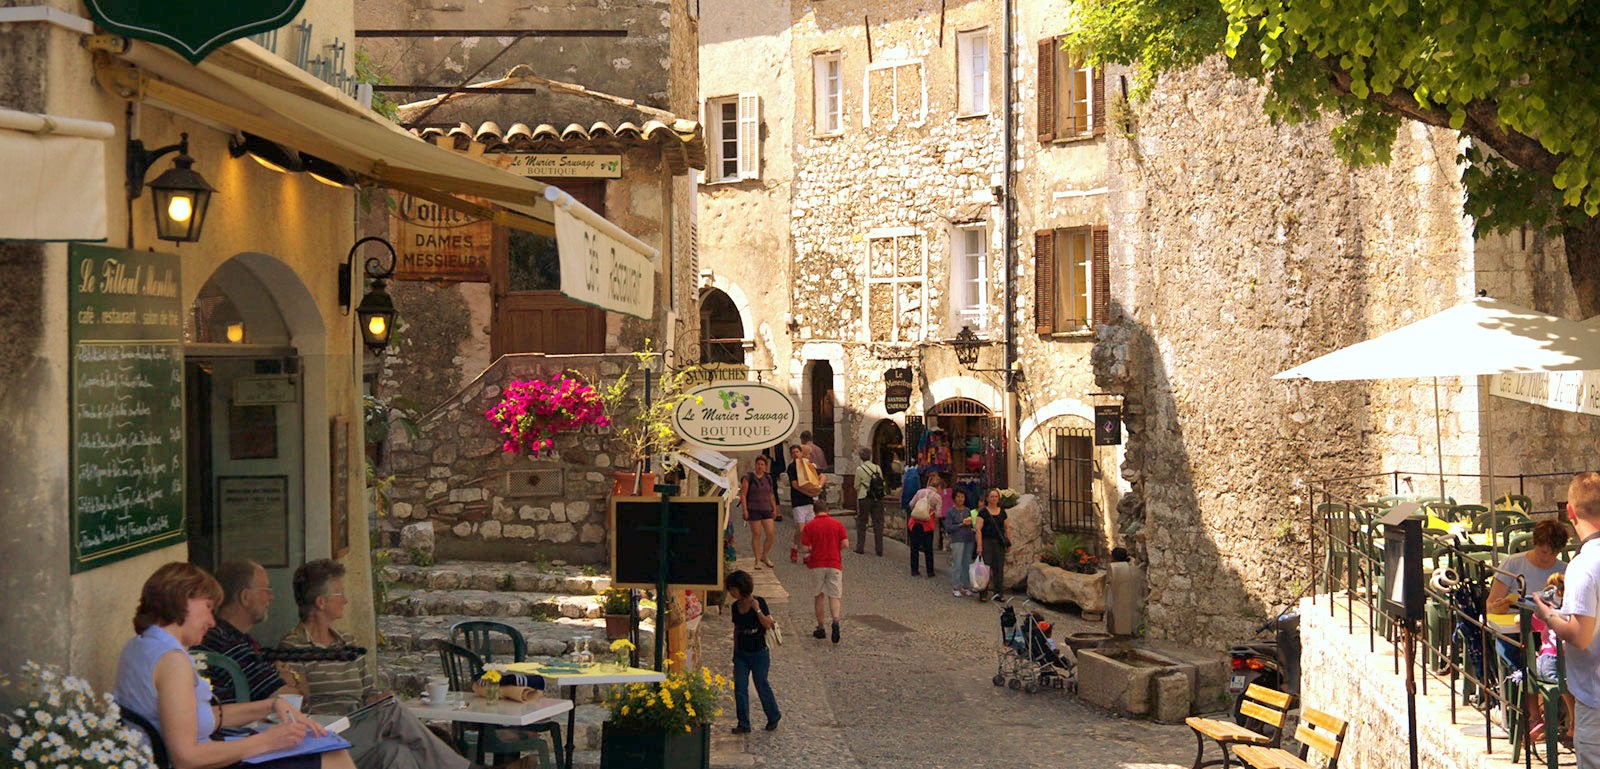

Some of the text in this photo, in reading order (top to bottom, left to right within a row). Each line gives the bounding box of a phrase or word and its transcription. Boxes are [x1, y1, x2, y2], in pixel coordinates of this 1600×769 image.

[512, 155, 595, 169] Le Murier Sauvage
[527, 167, 577, 176] BOUTIQUE
[415, 233, 474, 248] DAMES
[403, 253, 487, 268] MESSIEURS
[79, 258, 95, 293] Le
[78, 306, 94, 324] café
[101, 308, 137, 324] restaurant
[685, 367, 746, 385] SANDWICHES
[895, 370, 903, 379] Le
[682, 407, 789, 423] Le Murier Sauvage
[701, 426, 771, 438] BOUTIQUE
